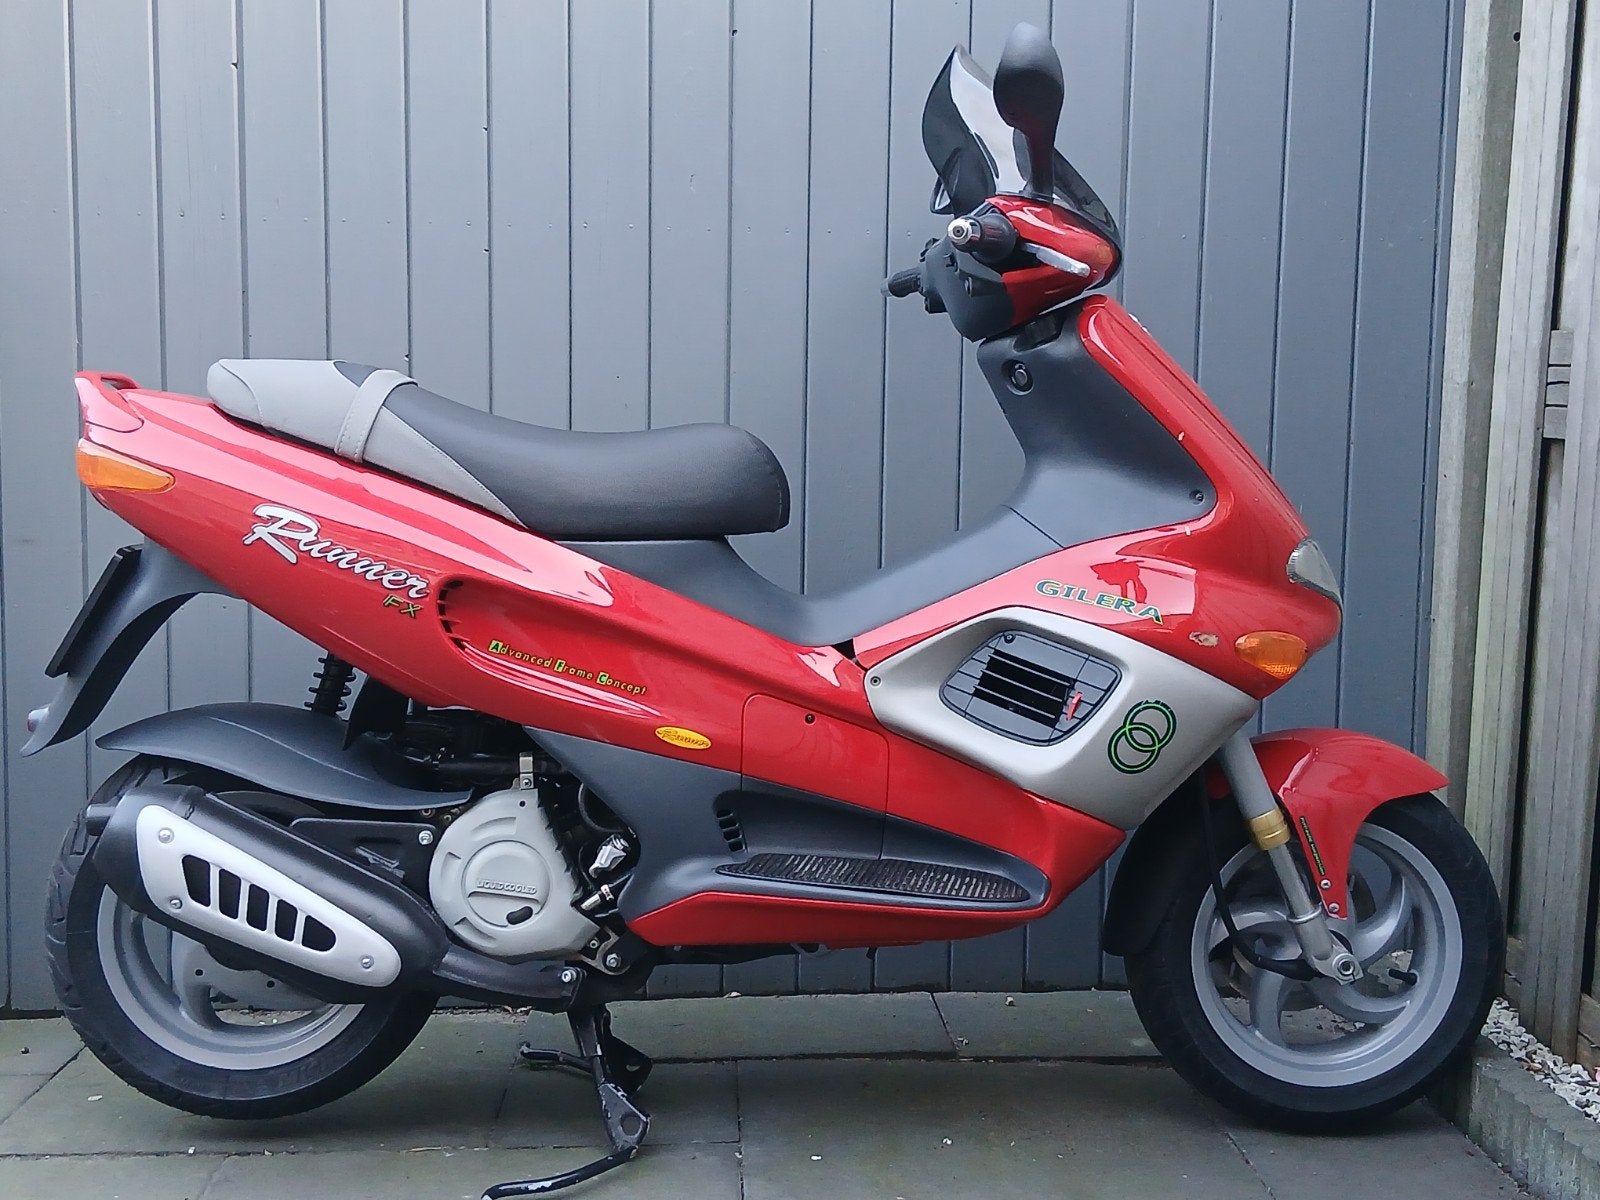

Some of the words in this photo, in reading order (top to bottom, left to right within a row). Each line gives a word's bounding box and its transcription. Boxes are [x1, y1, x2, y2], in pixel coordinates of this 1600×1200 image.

[242, 503, 430, 599] Runner
[383, 593, 422, 618] FX
[1035, 579, 1164, 626] GILERA
[488, 639, 552, 668] Advanced
[554, 659, 593, 680] Frame
[596, 671, 647, 695] Concept
